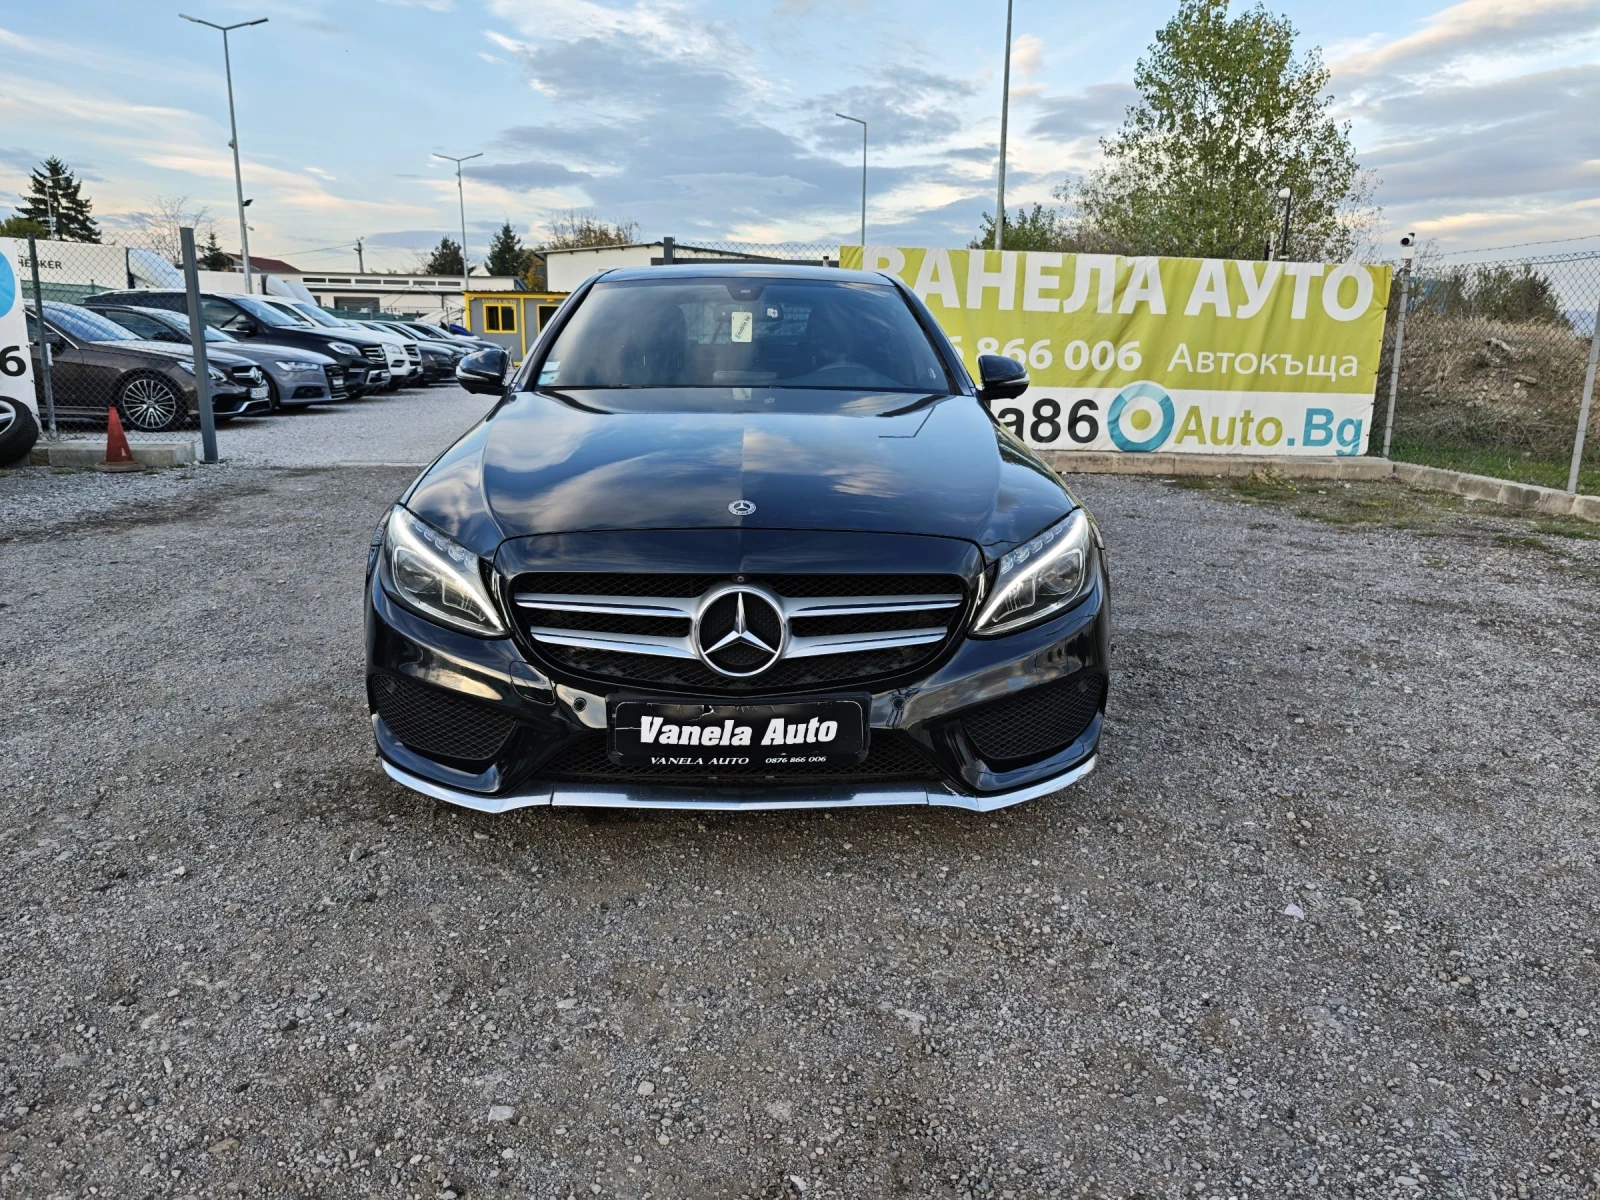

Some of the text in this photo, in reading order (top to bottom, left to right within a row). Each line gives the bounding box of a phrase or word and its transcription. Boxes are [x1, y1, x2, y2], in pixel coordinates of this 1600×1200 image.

[1184, 259, 1374, 322] АУТО
[976, 336, 1053, 370] 866
[1064, 339, 1143, 372] 006
[1167, 343, 1358, 382] Автокъща
[1174, 405, 1363, 457] Auto.Bg
[640, 715, 838, 746] Vanela Auto
[650, 757, 703, 765] VANELA
[708, 757, 749, 765] AUTO
